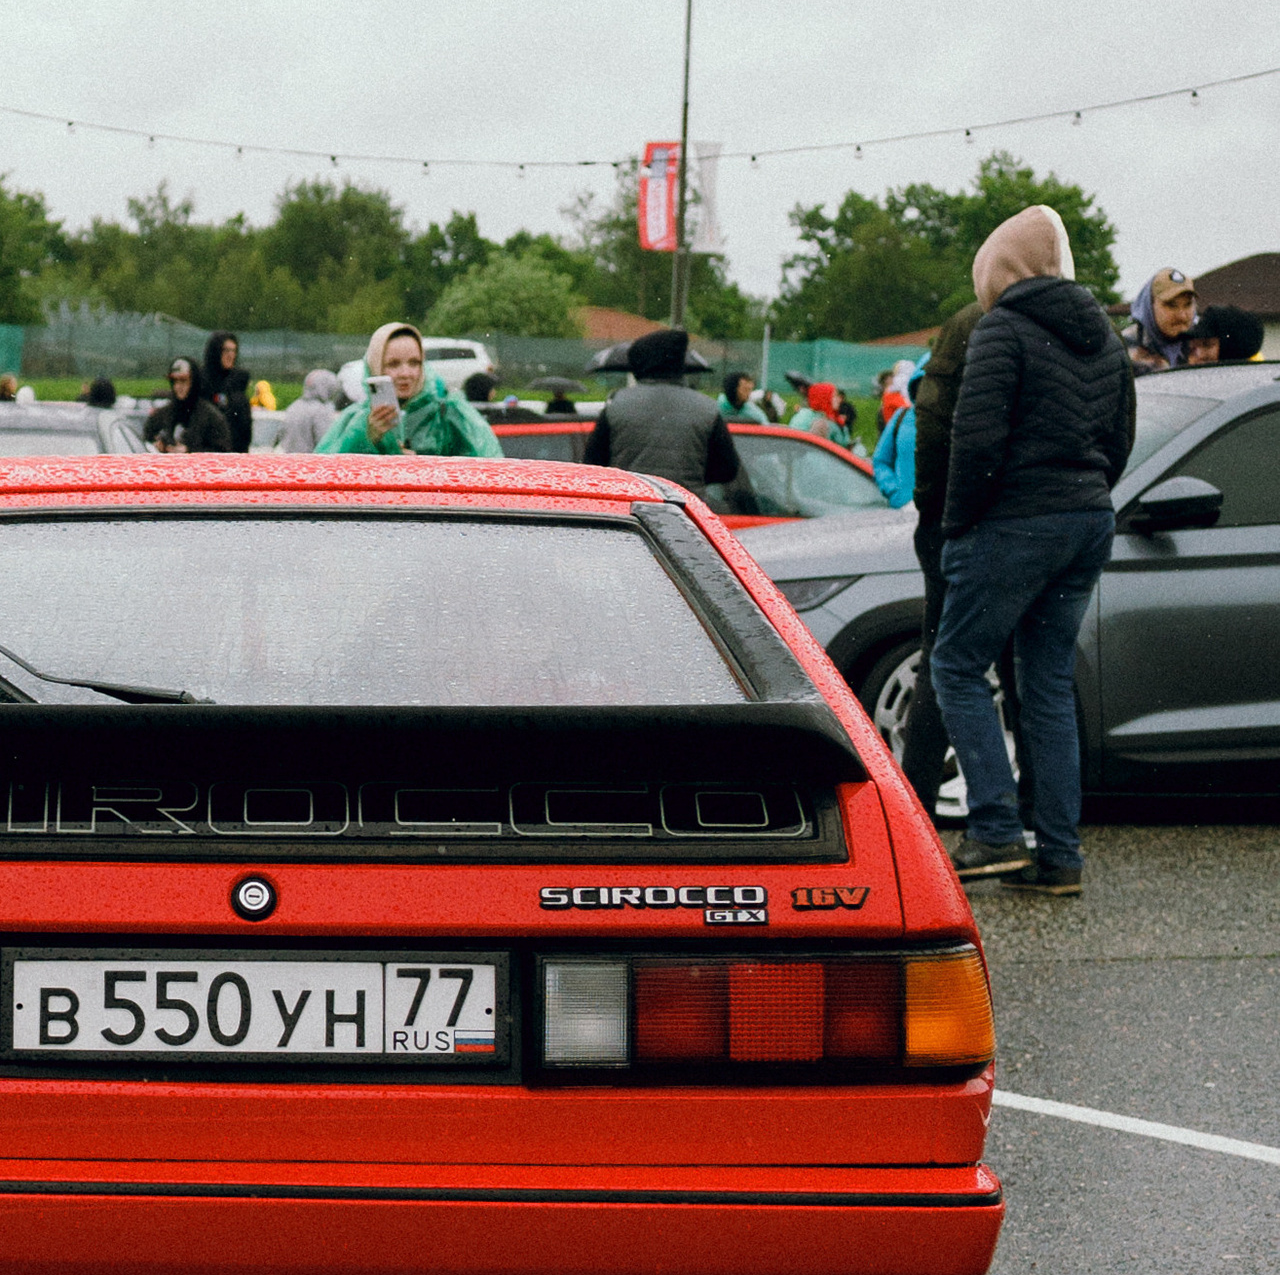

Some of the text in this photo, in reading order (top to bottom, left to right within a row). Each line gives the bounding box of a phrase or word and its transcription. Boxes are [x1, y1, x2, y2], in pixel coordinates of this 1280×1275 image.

[540, 885, 868, 907] SCIROCCO 16V
[707, 908, 764, 923] GTX
[395, 967, 475, 1027] 77
[392, 1030, 452, 1052] RUS
